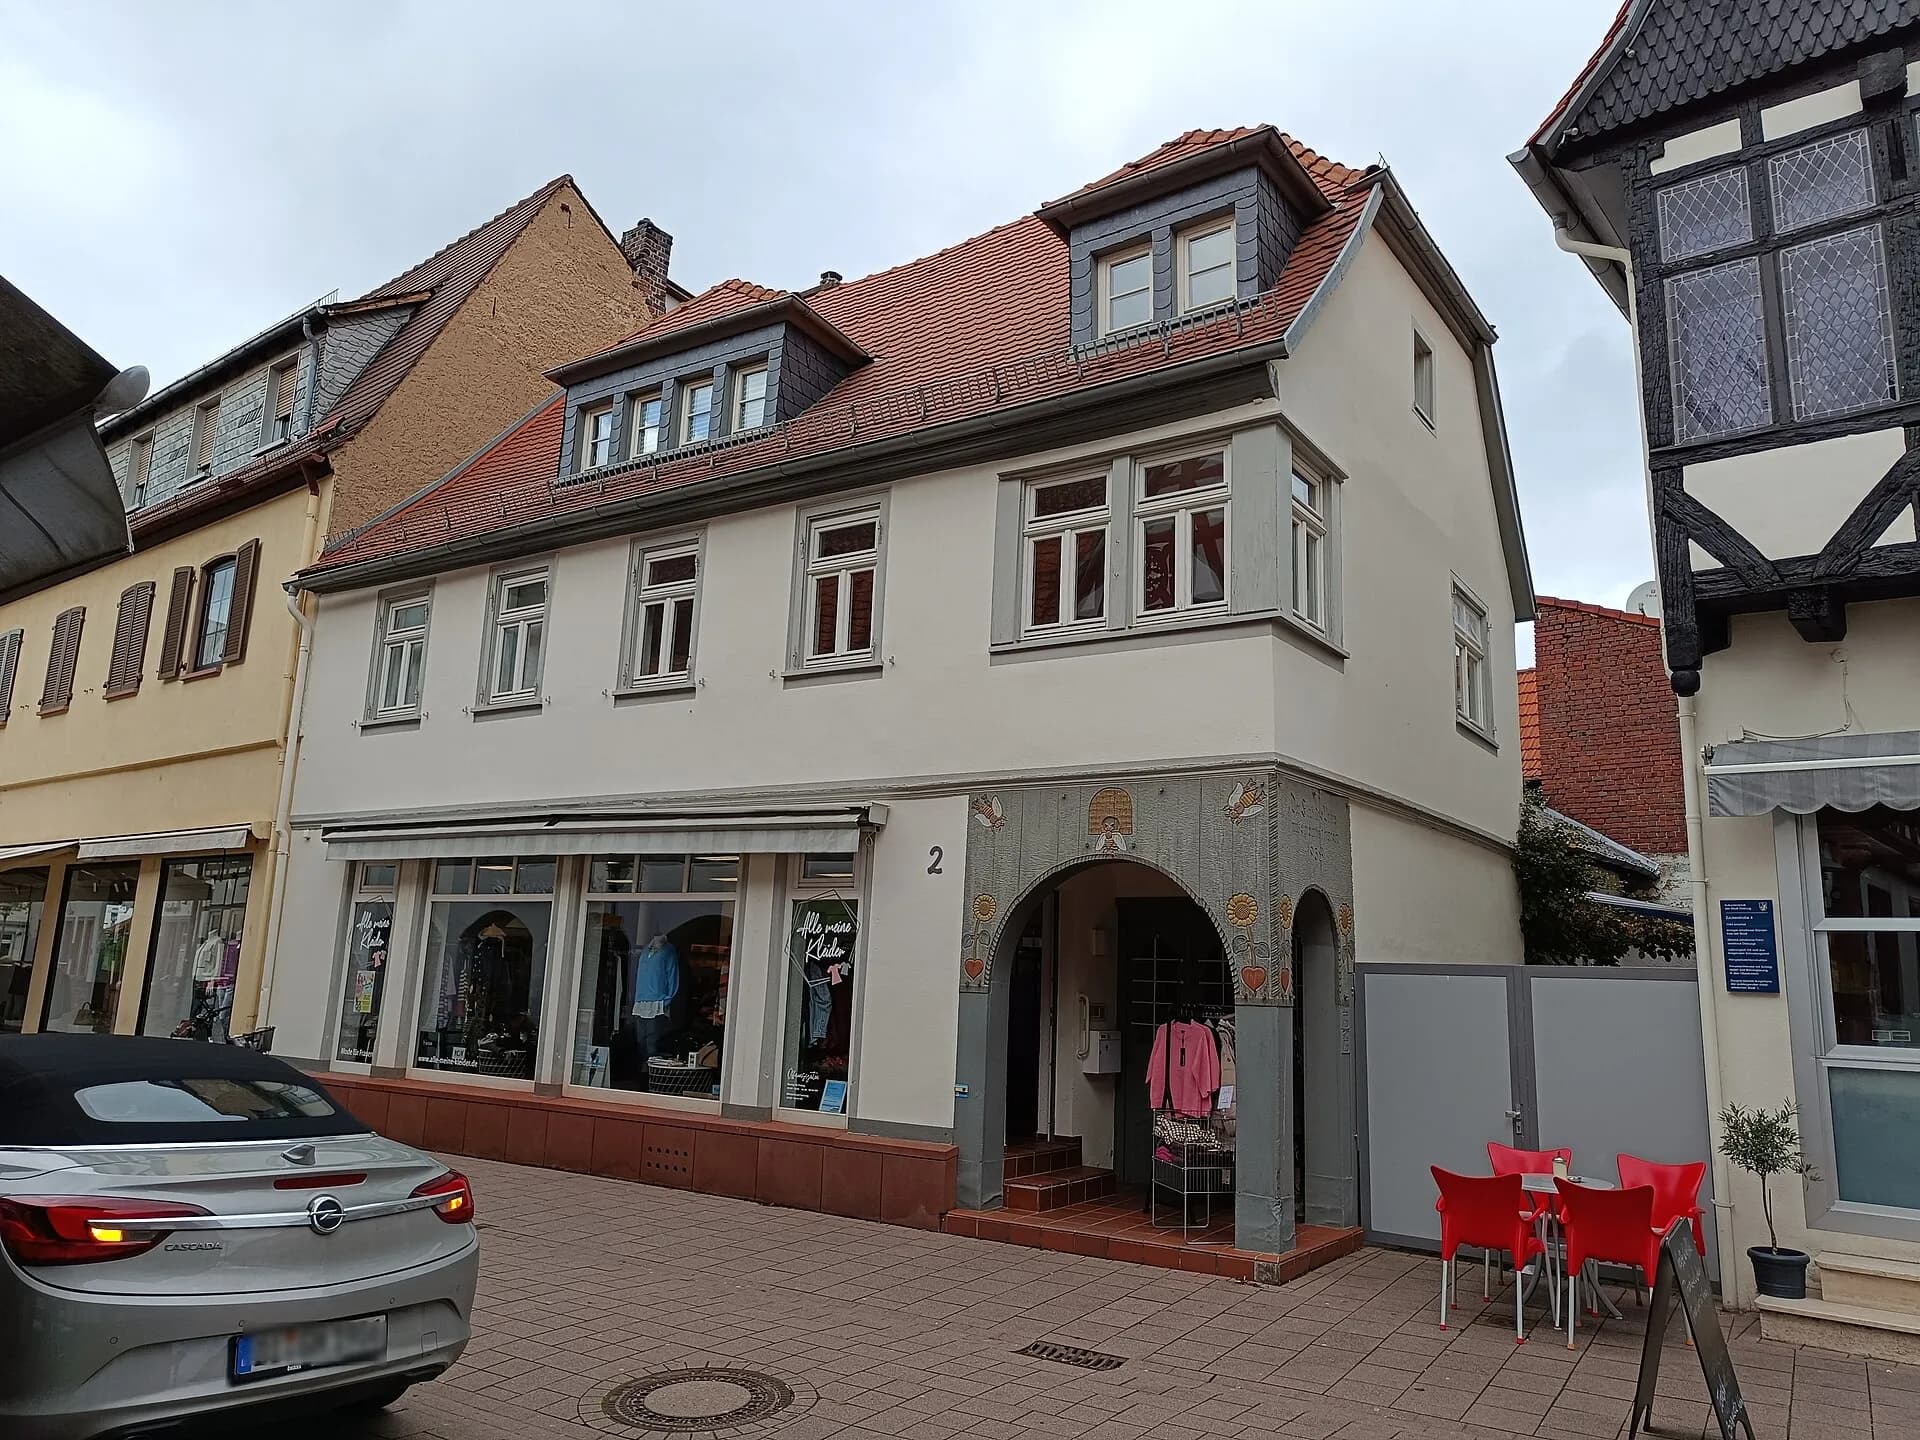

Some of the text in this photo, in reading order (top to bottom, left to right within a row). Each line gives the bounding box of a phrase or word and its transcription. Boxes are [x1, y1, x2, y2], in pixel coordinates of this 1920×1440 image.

[927, 845, 943, 875] 2
[796, 910, 853, 940] Alle meine
[805, 933, 846, 963] Kleider
[164, 1242, 223, 1251] CASCADA
